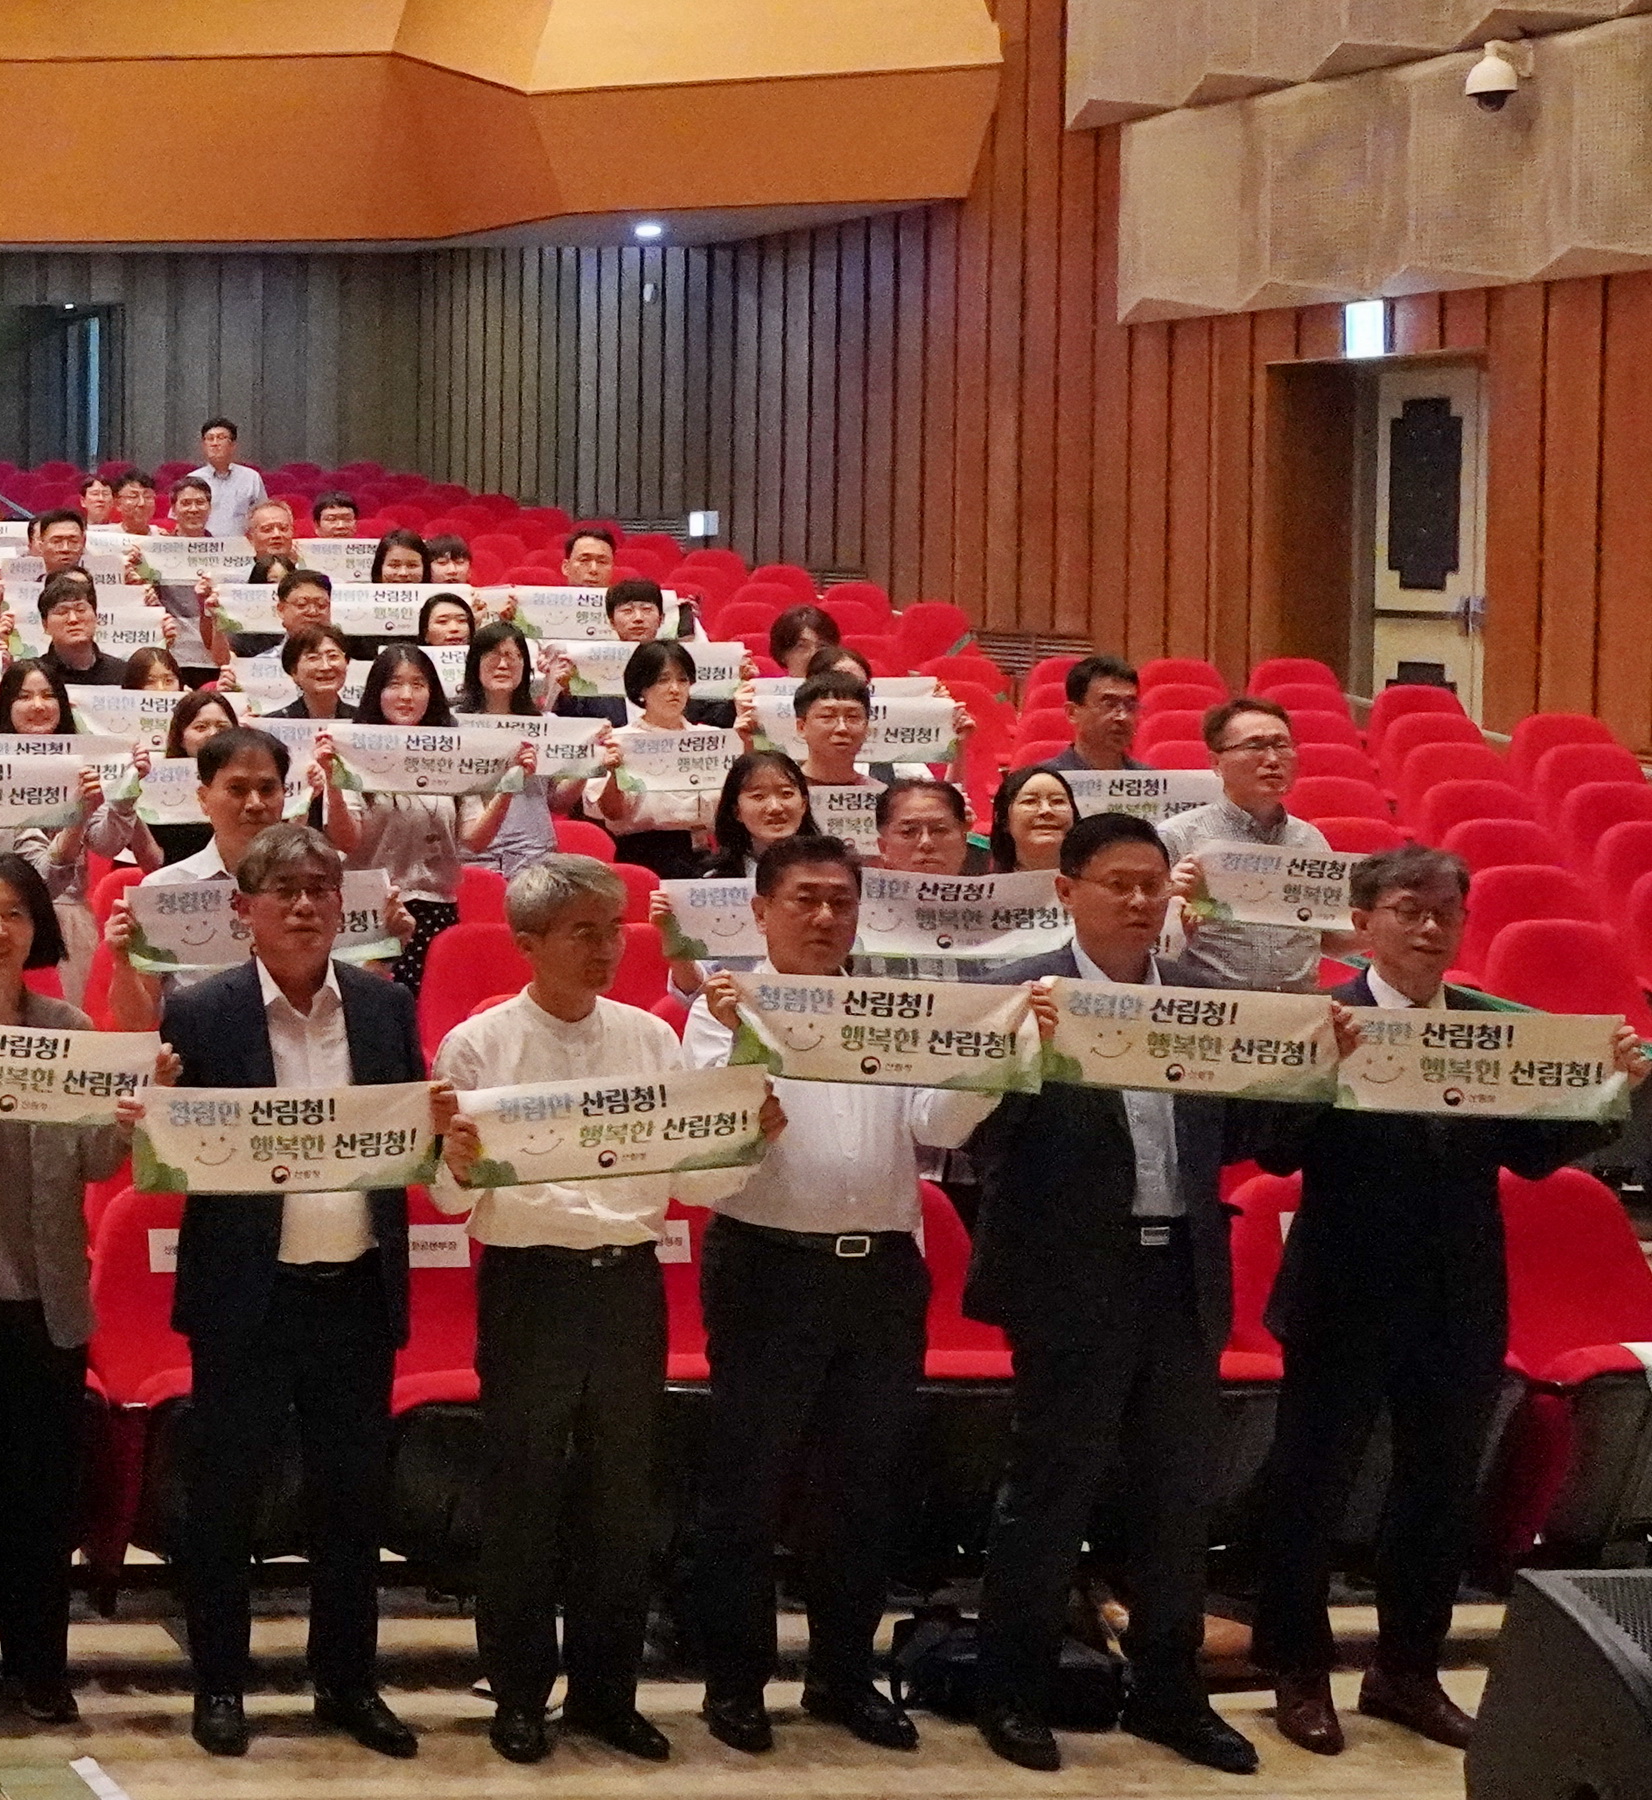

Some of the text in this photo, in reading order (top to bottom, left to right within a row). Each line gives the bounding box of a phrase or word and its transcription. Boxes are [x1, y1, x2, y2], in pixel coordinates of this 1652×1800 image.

[187, 541, 224, 552] 산림청!
[374, 590, 418, 602] 산림청!
[111, 629, 156, 644] 산림청!
[405, 735, 461, 753] 산림청!
[677, 736, 726, 751] 산림청!
[884, 727, 939, 744] 산림청!
[9, 786, 67, 805] 산림청!
[1108, 779, 1167, 796] 산림청!
[917, 881, 994, 901] 산림청!
[992, 905, 1070, 929] 산림청!
[842, 991, 934, 1017] 산림청!
[1150, 999, 1237, 1027] 산림청!
[842, 1026, 1016, 1058] 행복한 산림청!
[1421, 1022, 1514, 1048] 산림청!
[1147, 1034, 1317, 1065] 행복한 산림청!
[63, 1070, 148, 1097] 산림청!
[1420, 1057, 1603, 1087] 행복한 산림청!
[250, 1098, 335, 1125] 산림청!
[581, 1084, 666, 1115] 산림청!
[580, 1113, 747, 1146] 행복한 산림청!
[250, 1130, 416, 1160] 행복한 산림청!
